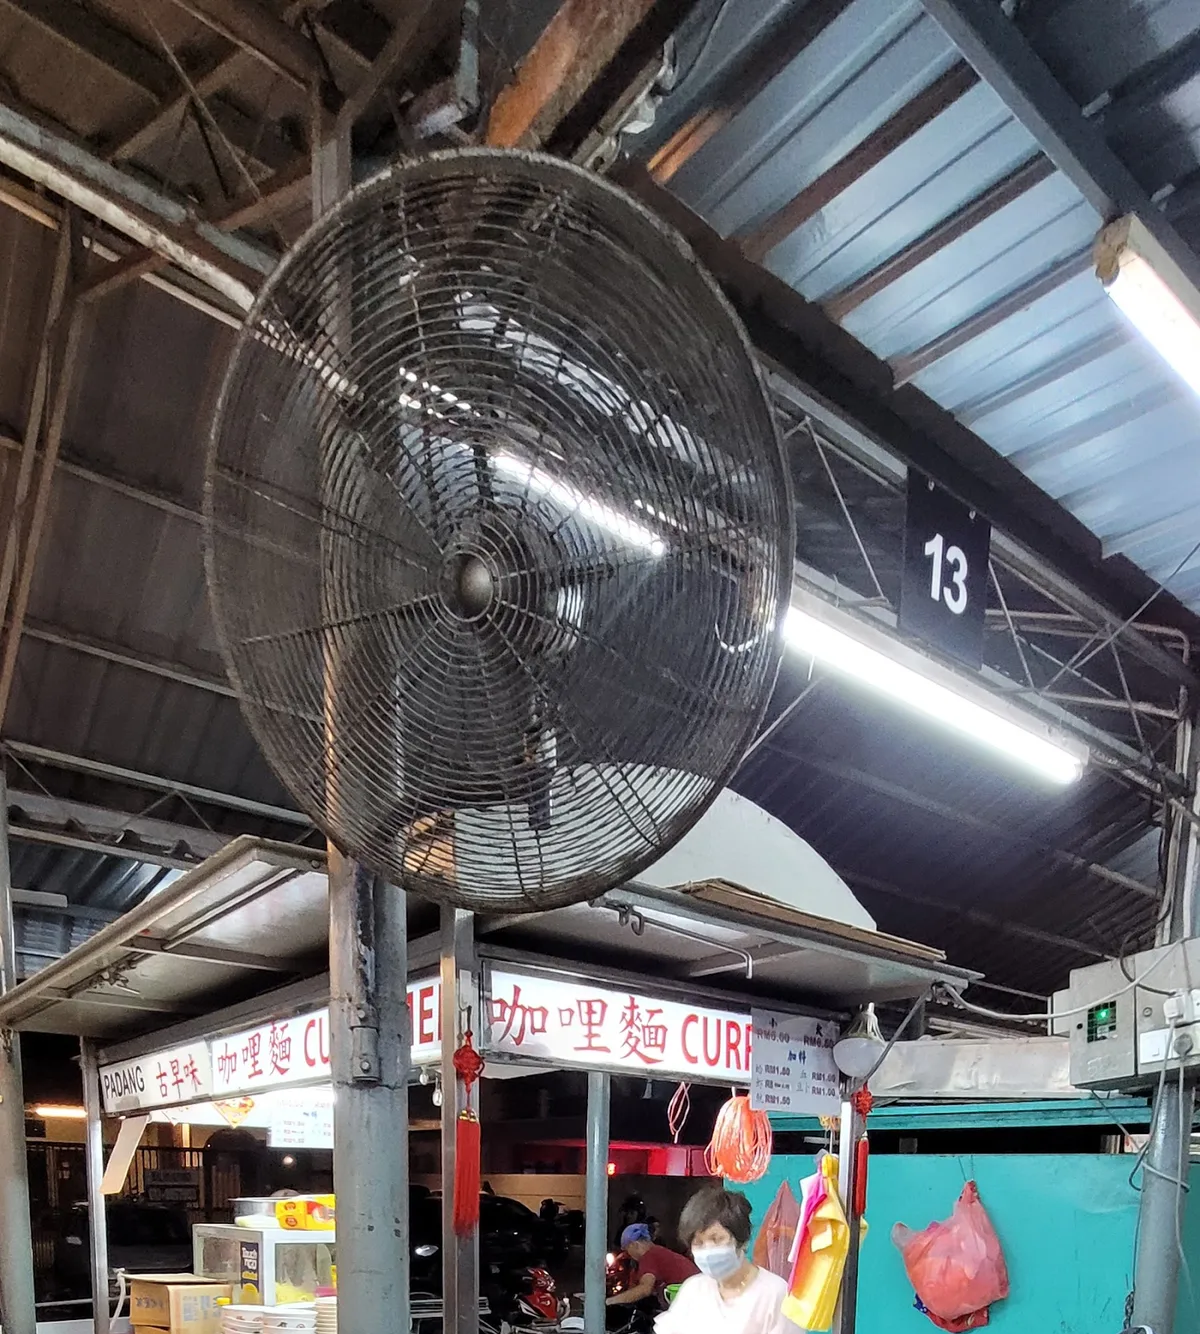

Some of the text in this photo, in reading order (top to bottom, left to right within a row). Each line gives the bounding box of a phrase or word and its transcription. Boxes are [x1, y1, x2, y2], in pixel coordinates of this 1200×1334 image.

[924, 533, 968, 614] 13
[218, 1021, 292, 1084] 咖哩麵
[487, 984, 668, 1064] 咖哩麵
[104, 1053, 202, 1099] PADANG 古早味
